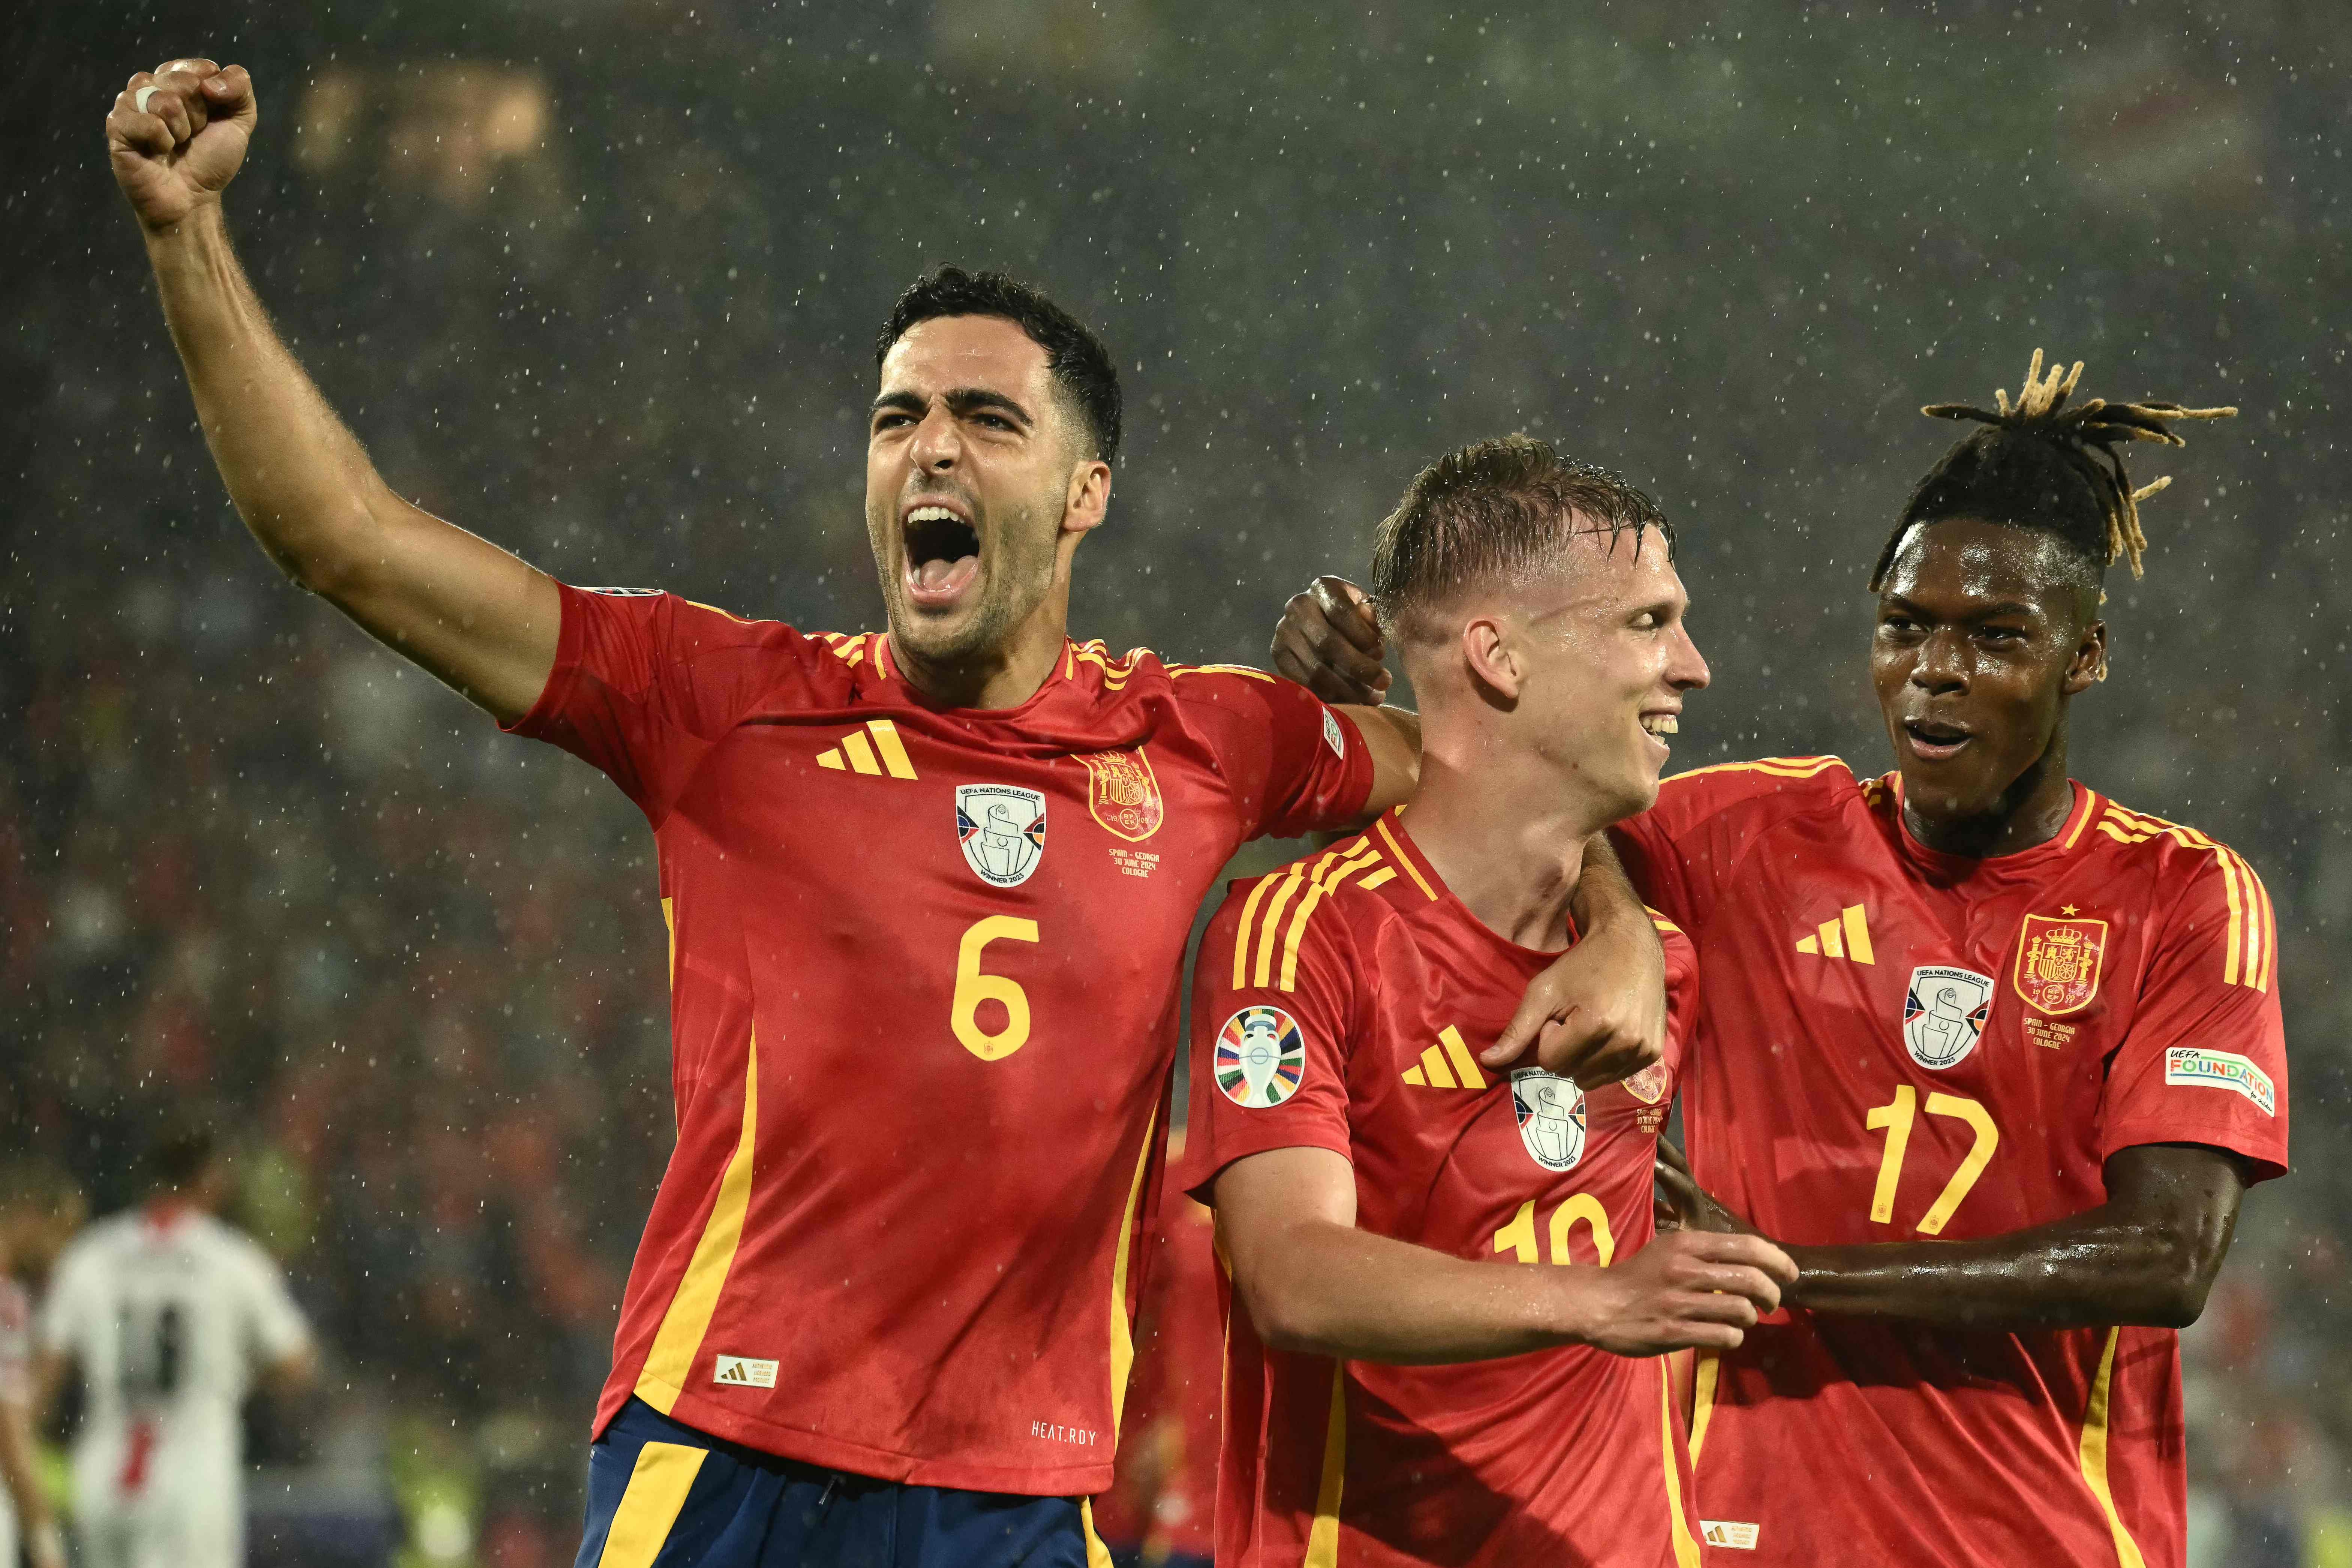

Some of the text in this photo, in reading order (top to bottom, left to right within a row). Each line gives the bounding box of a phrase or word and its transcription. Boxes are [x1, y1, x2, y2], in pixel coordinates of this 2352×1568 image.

[1013, 790, 1040, 801] LEAGUE
[1109, 848, 1128, 858] SPAIN
[1135, 852, 1160, 863] GEORGIA
[1124, 858, 1139, 868] JUNE
[1140, 861, 1156, 870] 2024
[981, 869, 1024, 883] WINNER 2023
[1122, 867, 1149, 878] COLOGNE
[1964, 973, 1990, 987] LEAGUE
[951, 915, 1040, 1061] 6
[2024, 1018, 2042, 1027] SPAIN
[2050, 1023, 2075, 1035] GEORGIA
[2027, 1026, 2070, 1042] 30 JUNE 2024
[2033, 1037, 2061, 1050] COLOGNE
[1914, 1050, 1955, 1065] WINNER 2023
[2170, 1050, 2200, 1058] UEFA
[1539, 1156, 1576, 1167] WINNER 2023
[1866, 1084, 1999, 1235] 17
[1494, 1193, 1615, 1268] 10
[1032, 1420, 1096, 1446] HEAT.RDY
